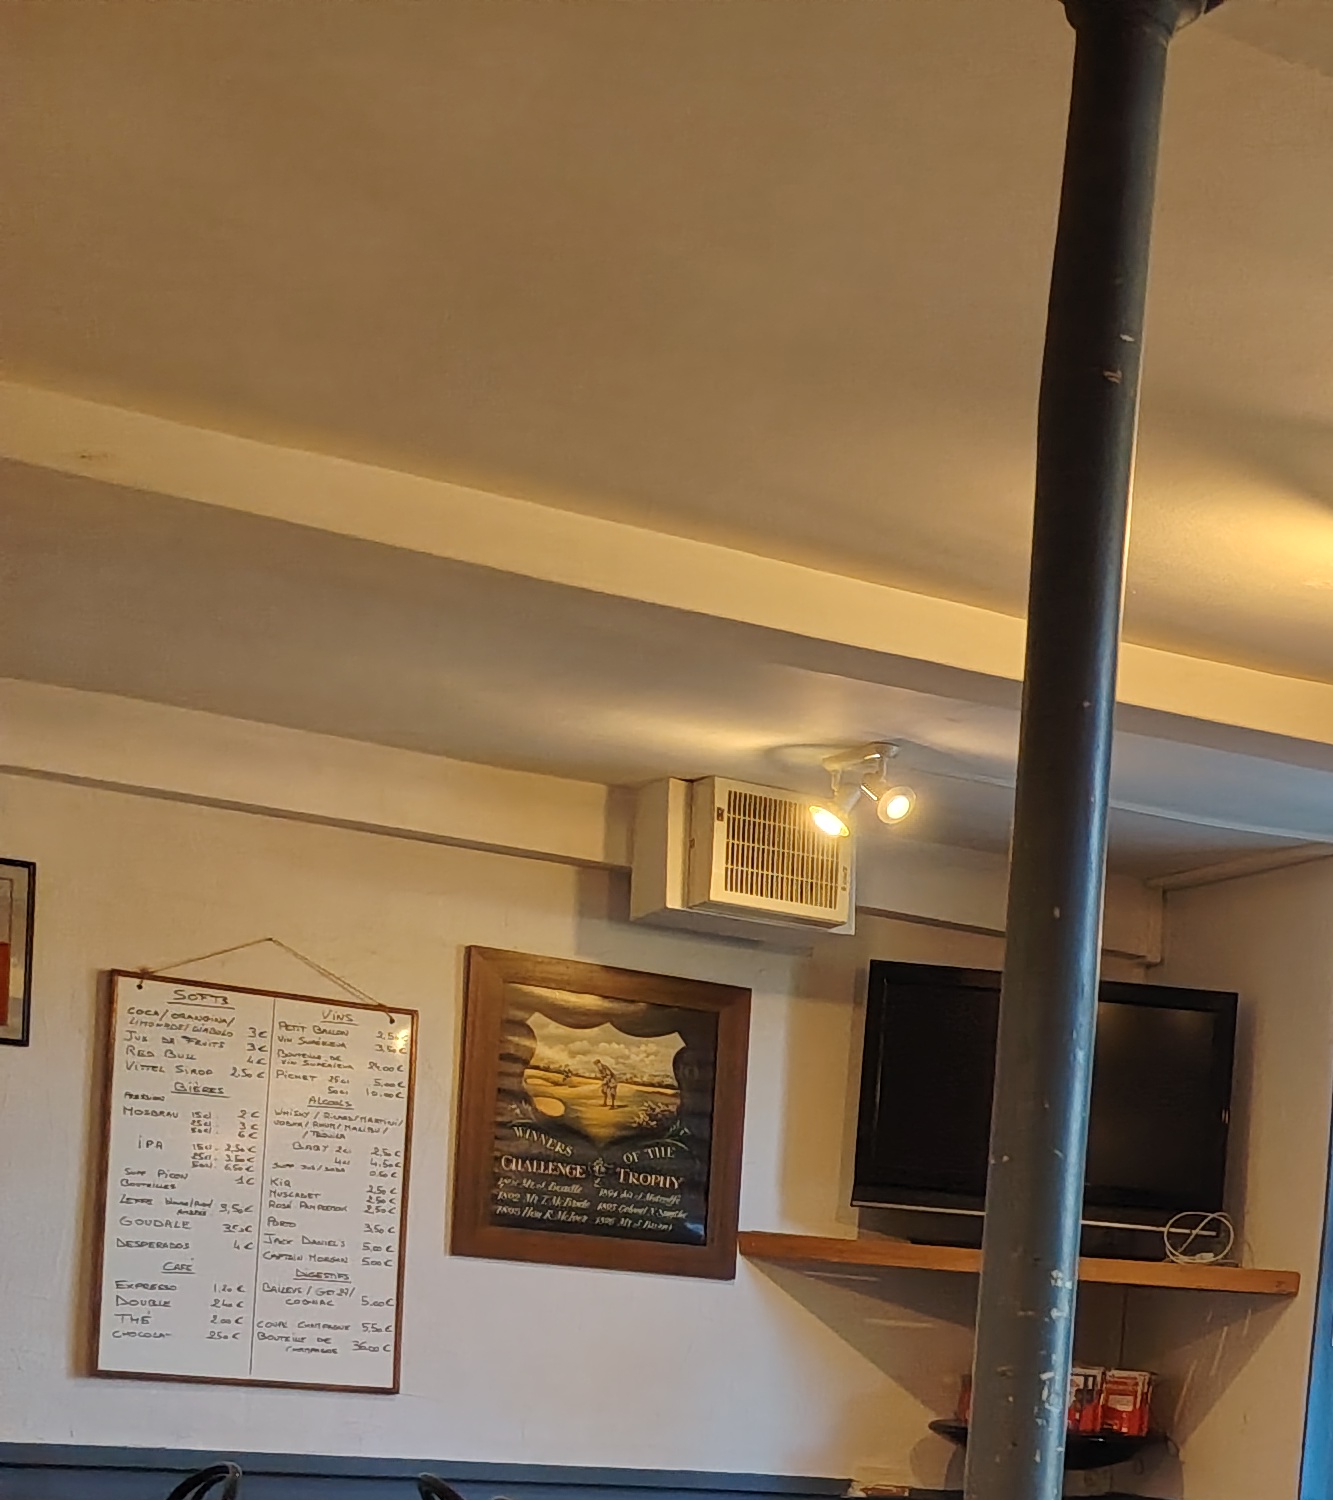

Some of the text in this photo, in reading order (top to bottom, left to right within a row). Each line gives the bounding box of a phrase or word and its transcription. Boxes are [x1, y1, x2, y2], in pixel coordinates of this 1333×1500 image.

[173, 989, 228, 1005] SOFTS
[513, 1127, 676, 1164] WINNERS OF THE
[501, 1155, 685, 1190] CHALLENGE TROPHY
[119, 1216, 192, 1230] GOUDALE
[116, 1238, 190, 1250] DESPERADOS
[116, 1295, 172, 1308] DOUBLE
